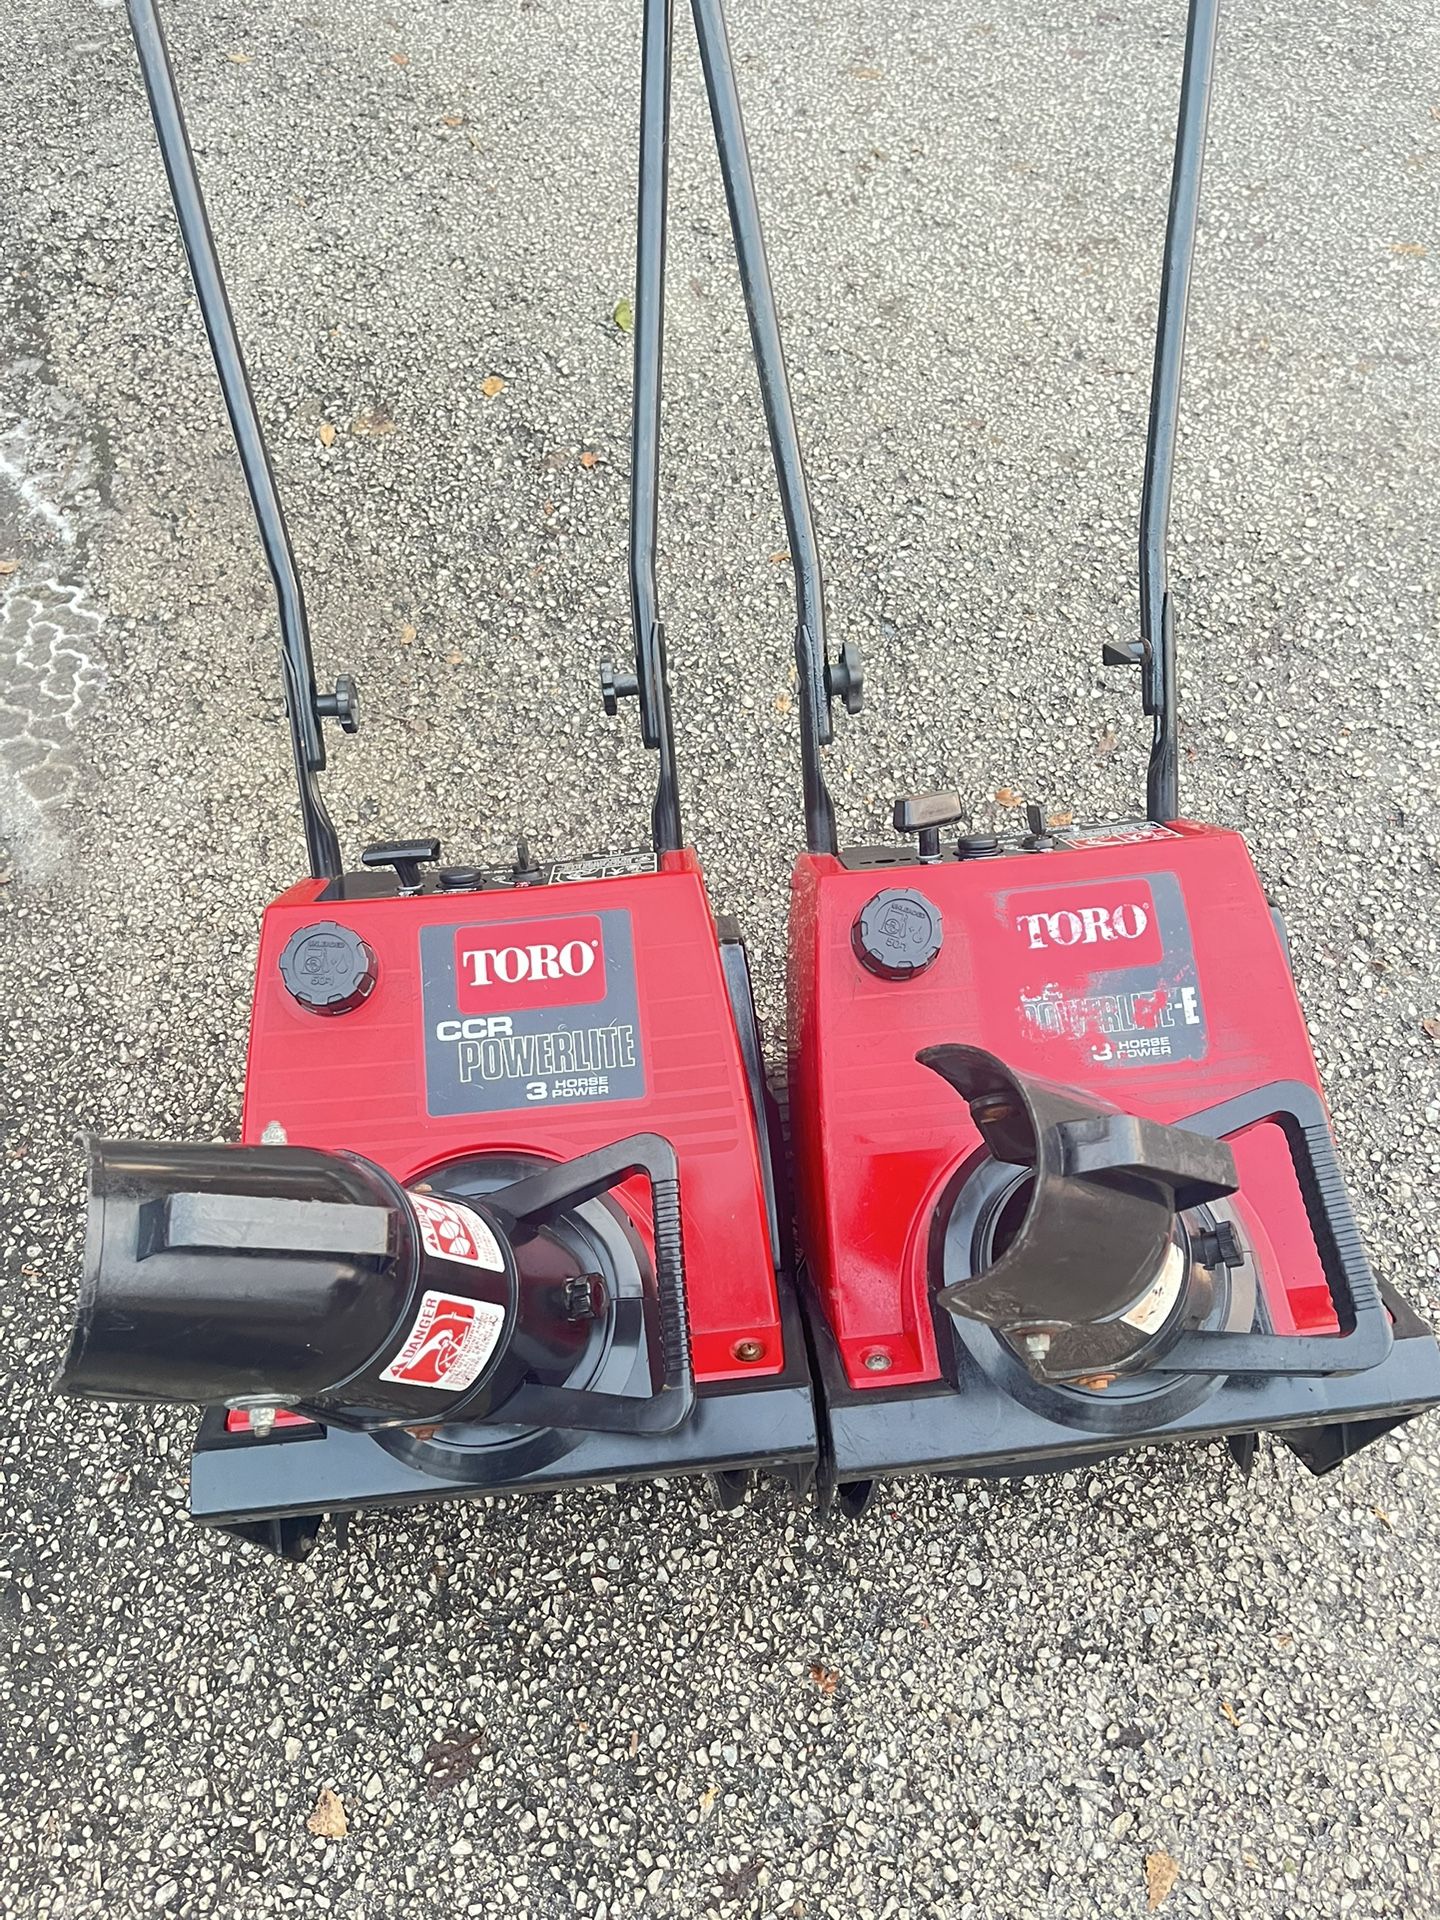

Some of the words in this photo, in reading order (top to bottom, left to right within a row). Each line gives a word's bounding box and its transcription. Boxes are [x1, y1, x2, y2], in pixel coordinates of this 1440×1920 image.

[1016, 903, 1147, 949] TORO
[462, 940, 595, 986] TORO
[436, 1016, 513, 1041] CCR
[458, 1025, 636, 1083] POWERLITE
[1091, 1043, 1113, 1061] 3
[1118, 1036, 1170, 1050] HORSE
[526, 1081, 548, 1101] 3
[552, 1084, 609, 1098] POWER
[555, 1075, 609, 1089] HORSE
[402, 1298, 437, 1360] DANGER
